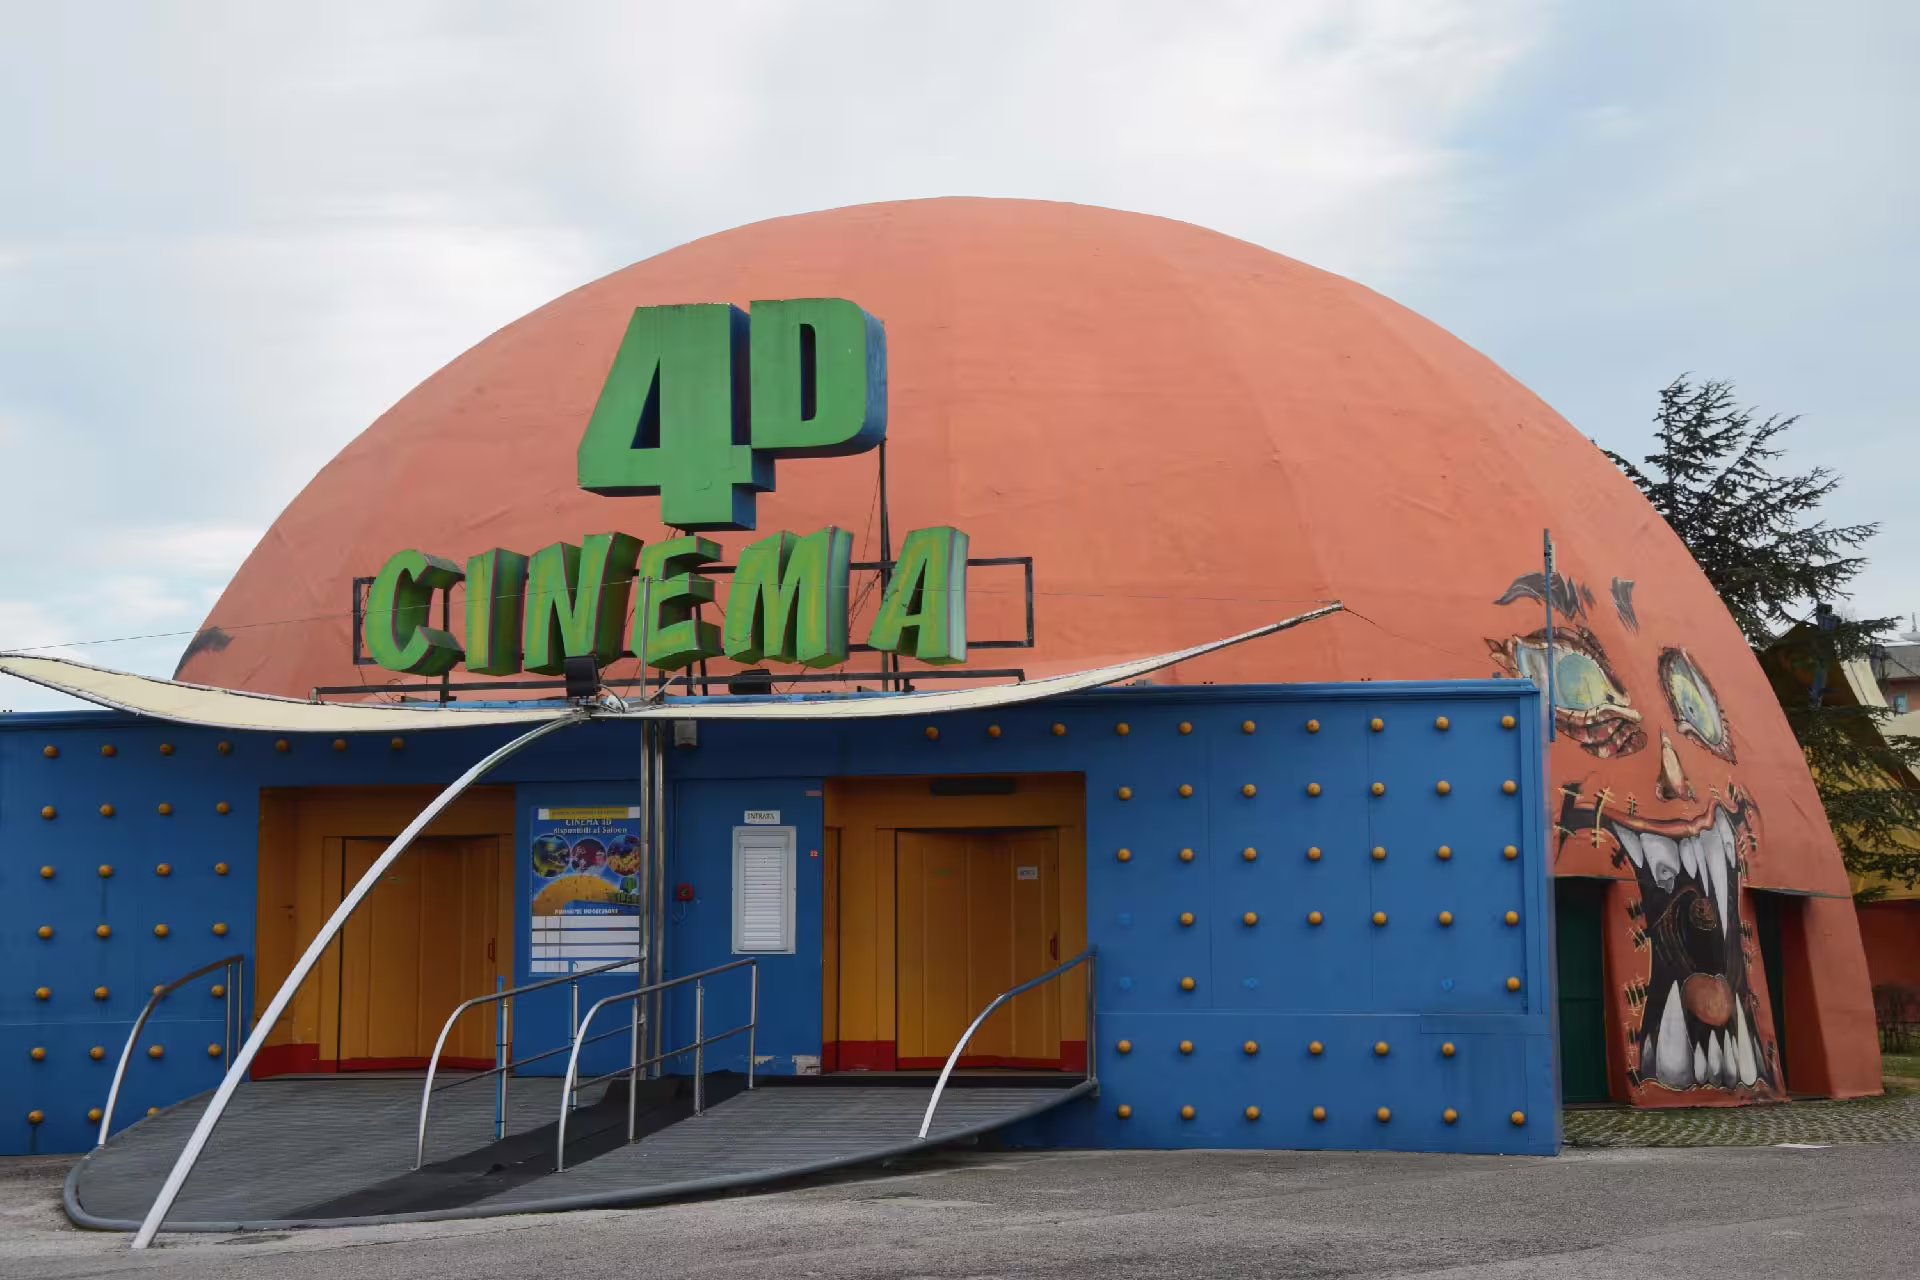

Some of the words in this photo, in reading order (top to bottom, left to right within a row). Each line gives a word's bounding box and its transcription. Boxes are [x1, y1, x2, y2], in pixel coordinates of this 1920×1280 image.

[577, 297, 887, 531] 4D
[365, 525, 970, 676] CINEMA
[565, 818, 599, 826] CINEMA
